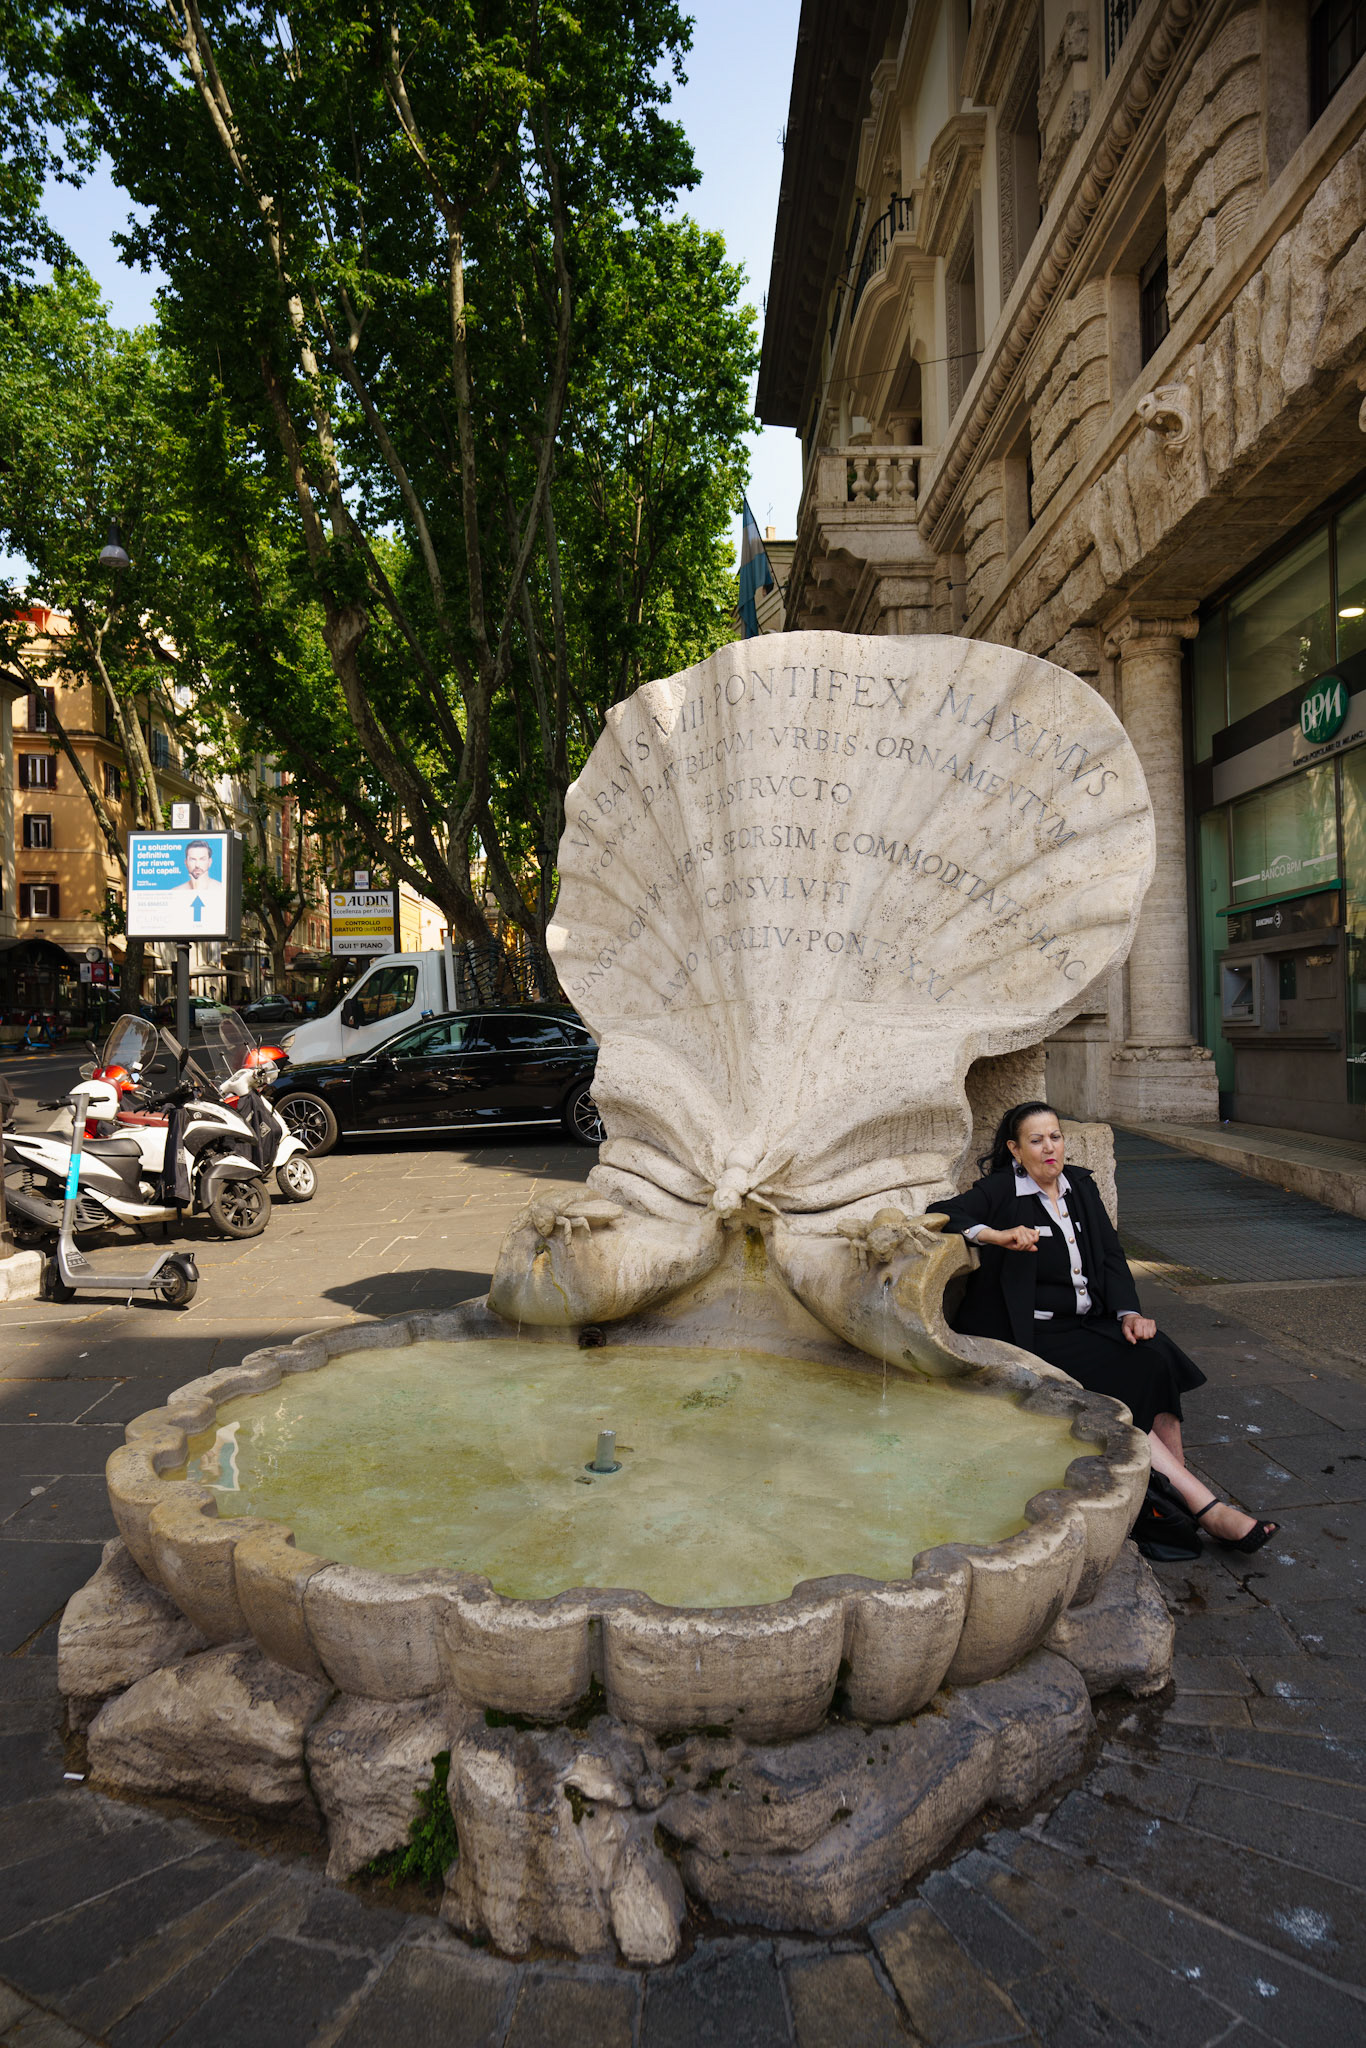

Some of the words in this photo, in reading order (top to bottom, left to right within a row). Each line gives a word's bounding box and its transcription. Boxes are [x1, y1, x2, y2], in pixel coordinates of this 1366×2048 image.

[1300, 682, 1342, 735] BPM
[713, 666, 909, 717] PONTIFEX
[936, 685, 1118, 797] MAXIMVS
[705, 775, 852, 815] EXSTRVCTO
[768, 726, 857, 756] VRBIS
[875, 737, 1077, 848] ORNAMENTVM
[156, 867, 181, 875] capelli.
[1261, 865, 1286, 881] BANCO
[1287, 860, 1302, 874] BPM
[347, 895, 389, 906] AUDIN
[705, 876, 850, 908] CONSVLVIT
[723, 825, 817, 856] SEORSIM
[833, 831, 1028, 927] COMMODITATE
[1027, 923, 1087, 981] HAC
[806, 929, 888, 961] PONT
